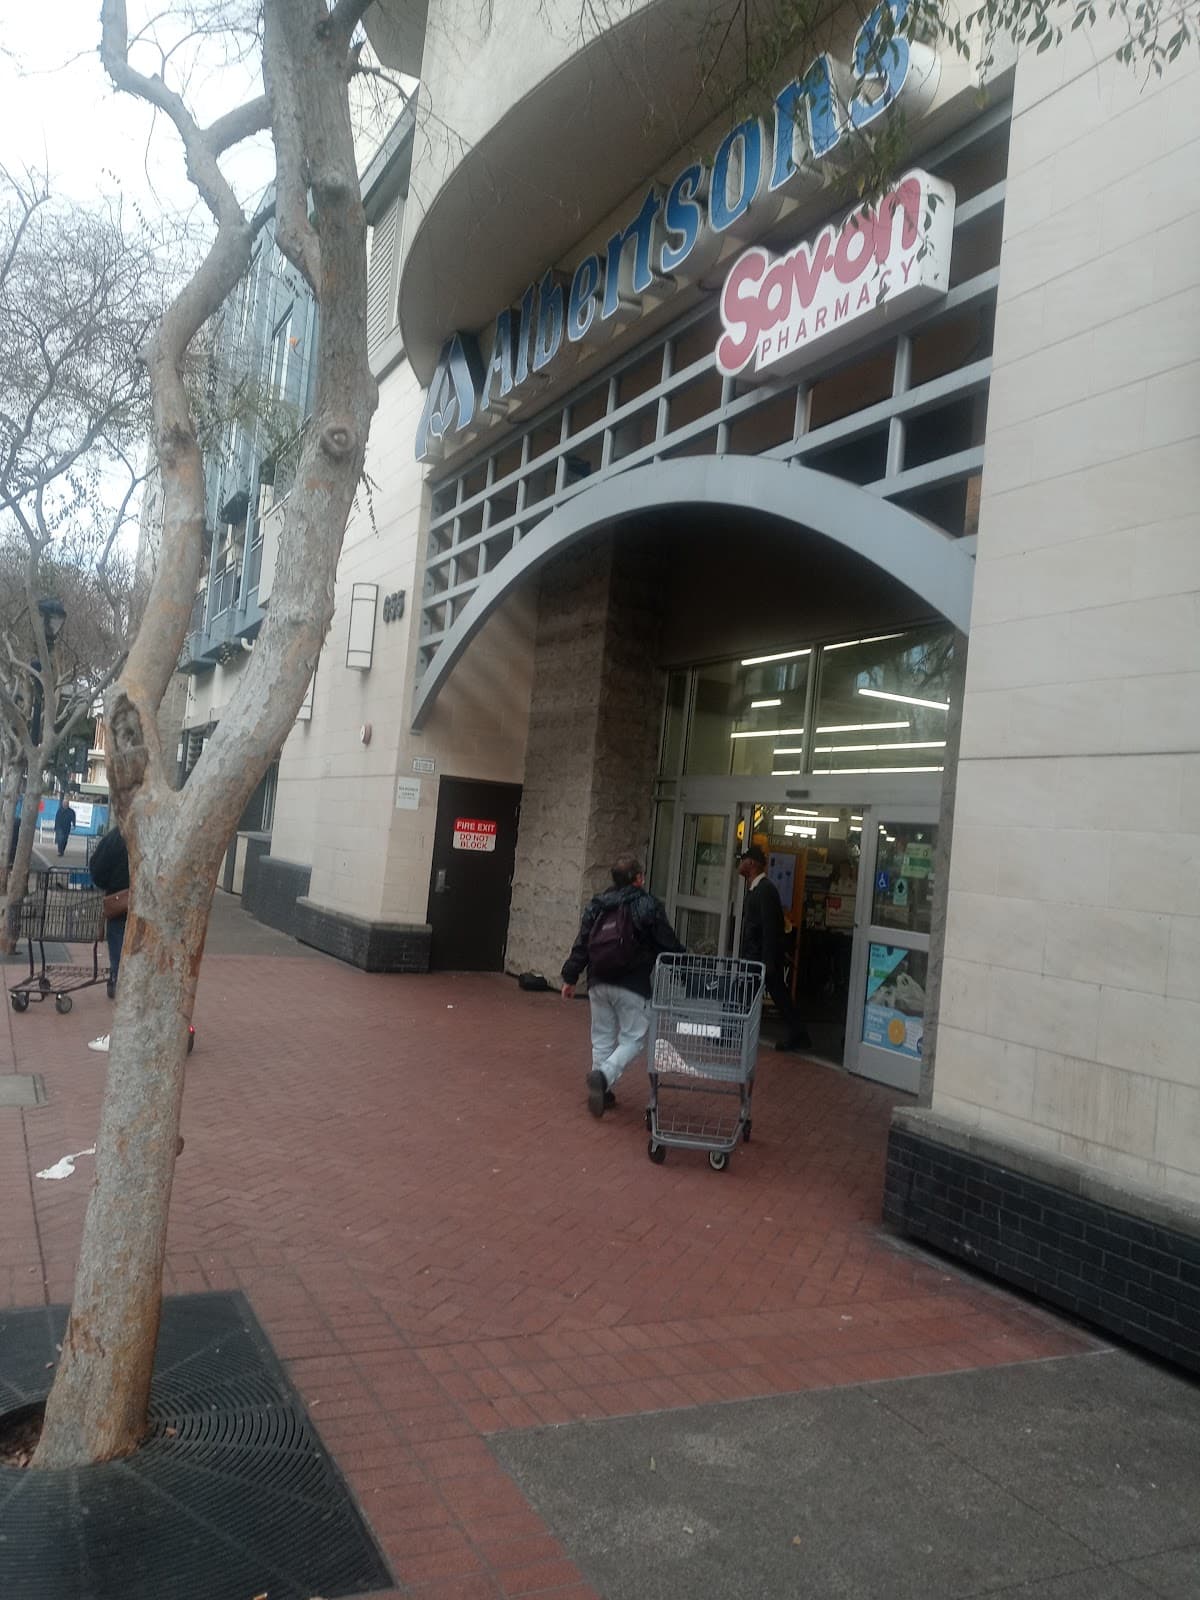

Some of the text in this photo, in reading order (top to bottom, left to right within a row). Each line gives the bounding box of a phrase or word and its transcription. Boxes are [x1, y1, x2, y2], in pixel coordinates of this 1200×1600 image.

[480, 0, 911, 412] Albertsons
[760, 255, 915, 362] PHARMACY
[456, 821, 496, 833] FIRE EXIT
[460, 833, 489, 842] DO NOT
[460, 841, 488, 850] BLOCK
